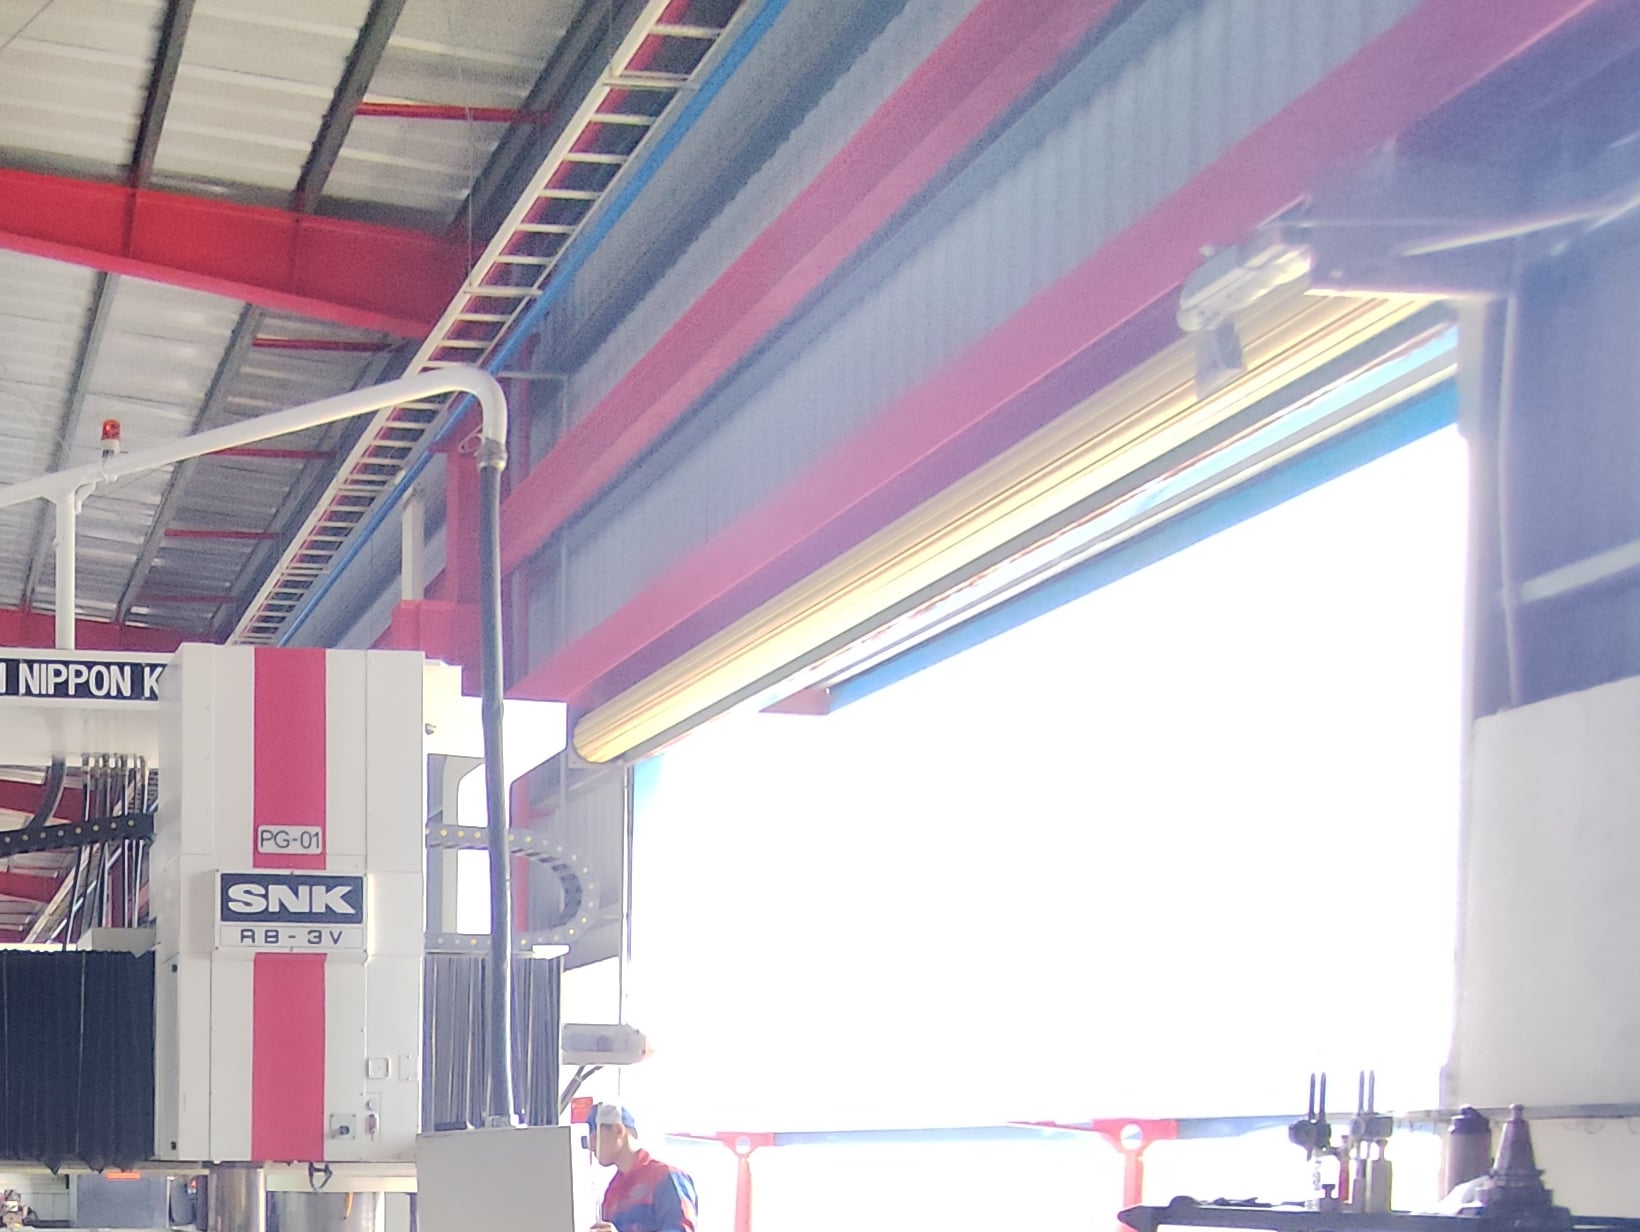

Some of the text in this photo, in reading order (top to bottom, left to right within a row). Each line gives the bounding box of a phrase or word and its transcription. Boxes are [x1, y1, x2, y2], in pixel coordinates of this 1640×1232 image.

[19, 662, 131, 697] NIPPON
[144, 667, 163, 698] K
[260, 830, 320, 849] PG-01
[227, 883, 356, 914] SNK
[240, 929, 343, 945] RB-3V
